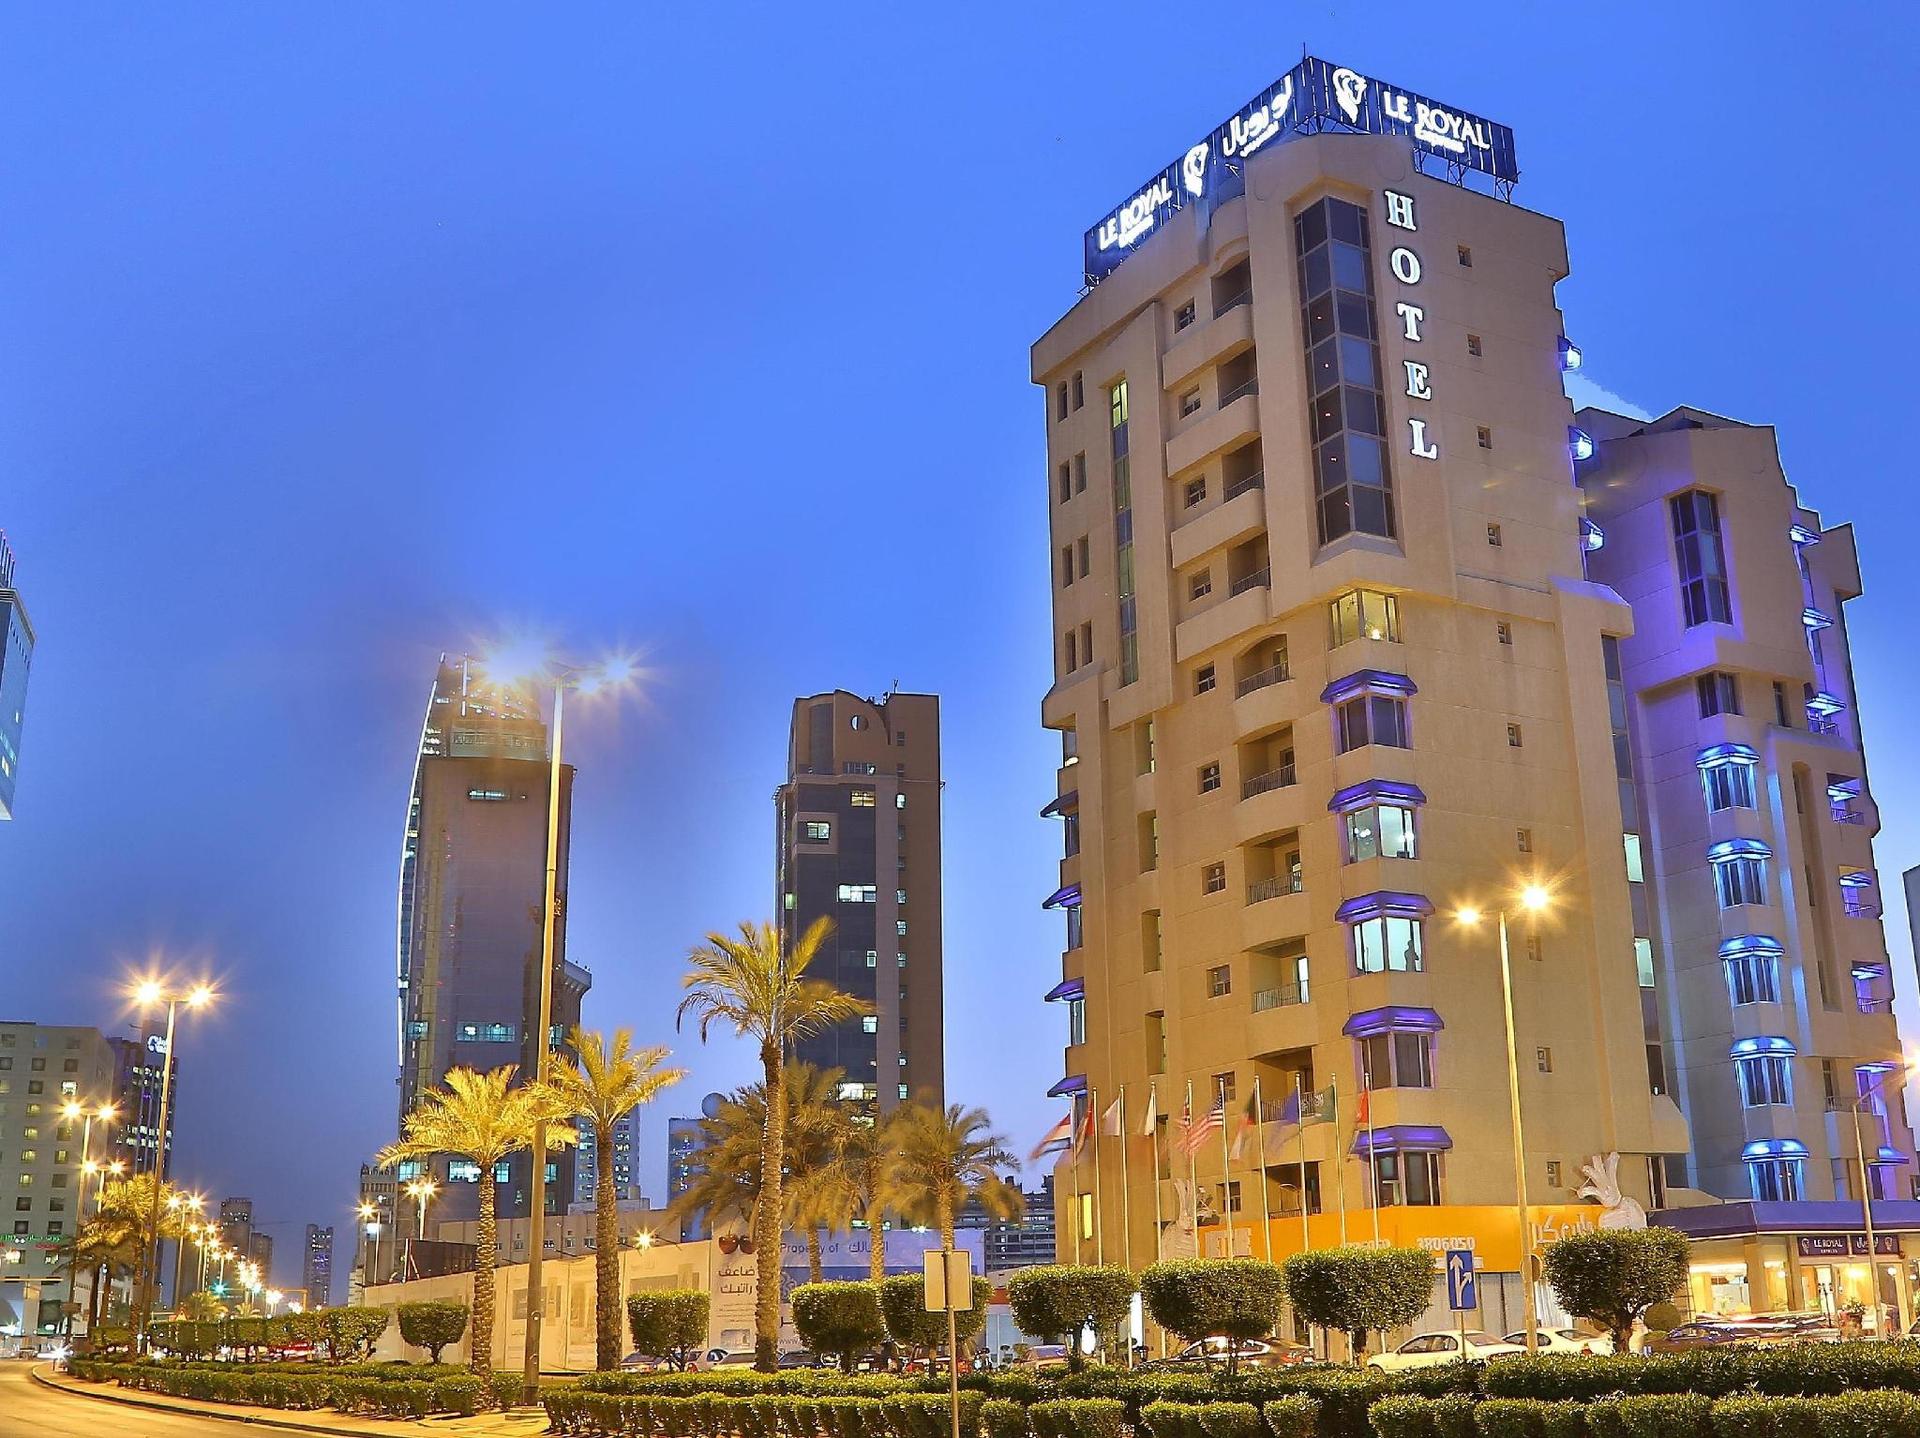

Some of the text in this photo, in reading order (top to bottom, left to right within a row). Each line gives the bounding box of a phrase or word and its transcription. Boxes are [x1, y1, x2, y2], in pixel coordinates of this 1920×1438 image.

[1383, 90, 1491, 150] LE ROYAL
[1099, 217, 1118, 250] LE
[1119, 177, 1173, 235] ROYAL
[1384, 190, 1438, 460] HOTEL
[829, 1243, 839, 1253] of
[1814, 1239, 1843, 1248] LE ROYAL
[718, 1264, 756, 1277] ضاعف
[720, 1282, 753, 1297] راتبك
